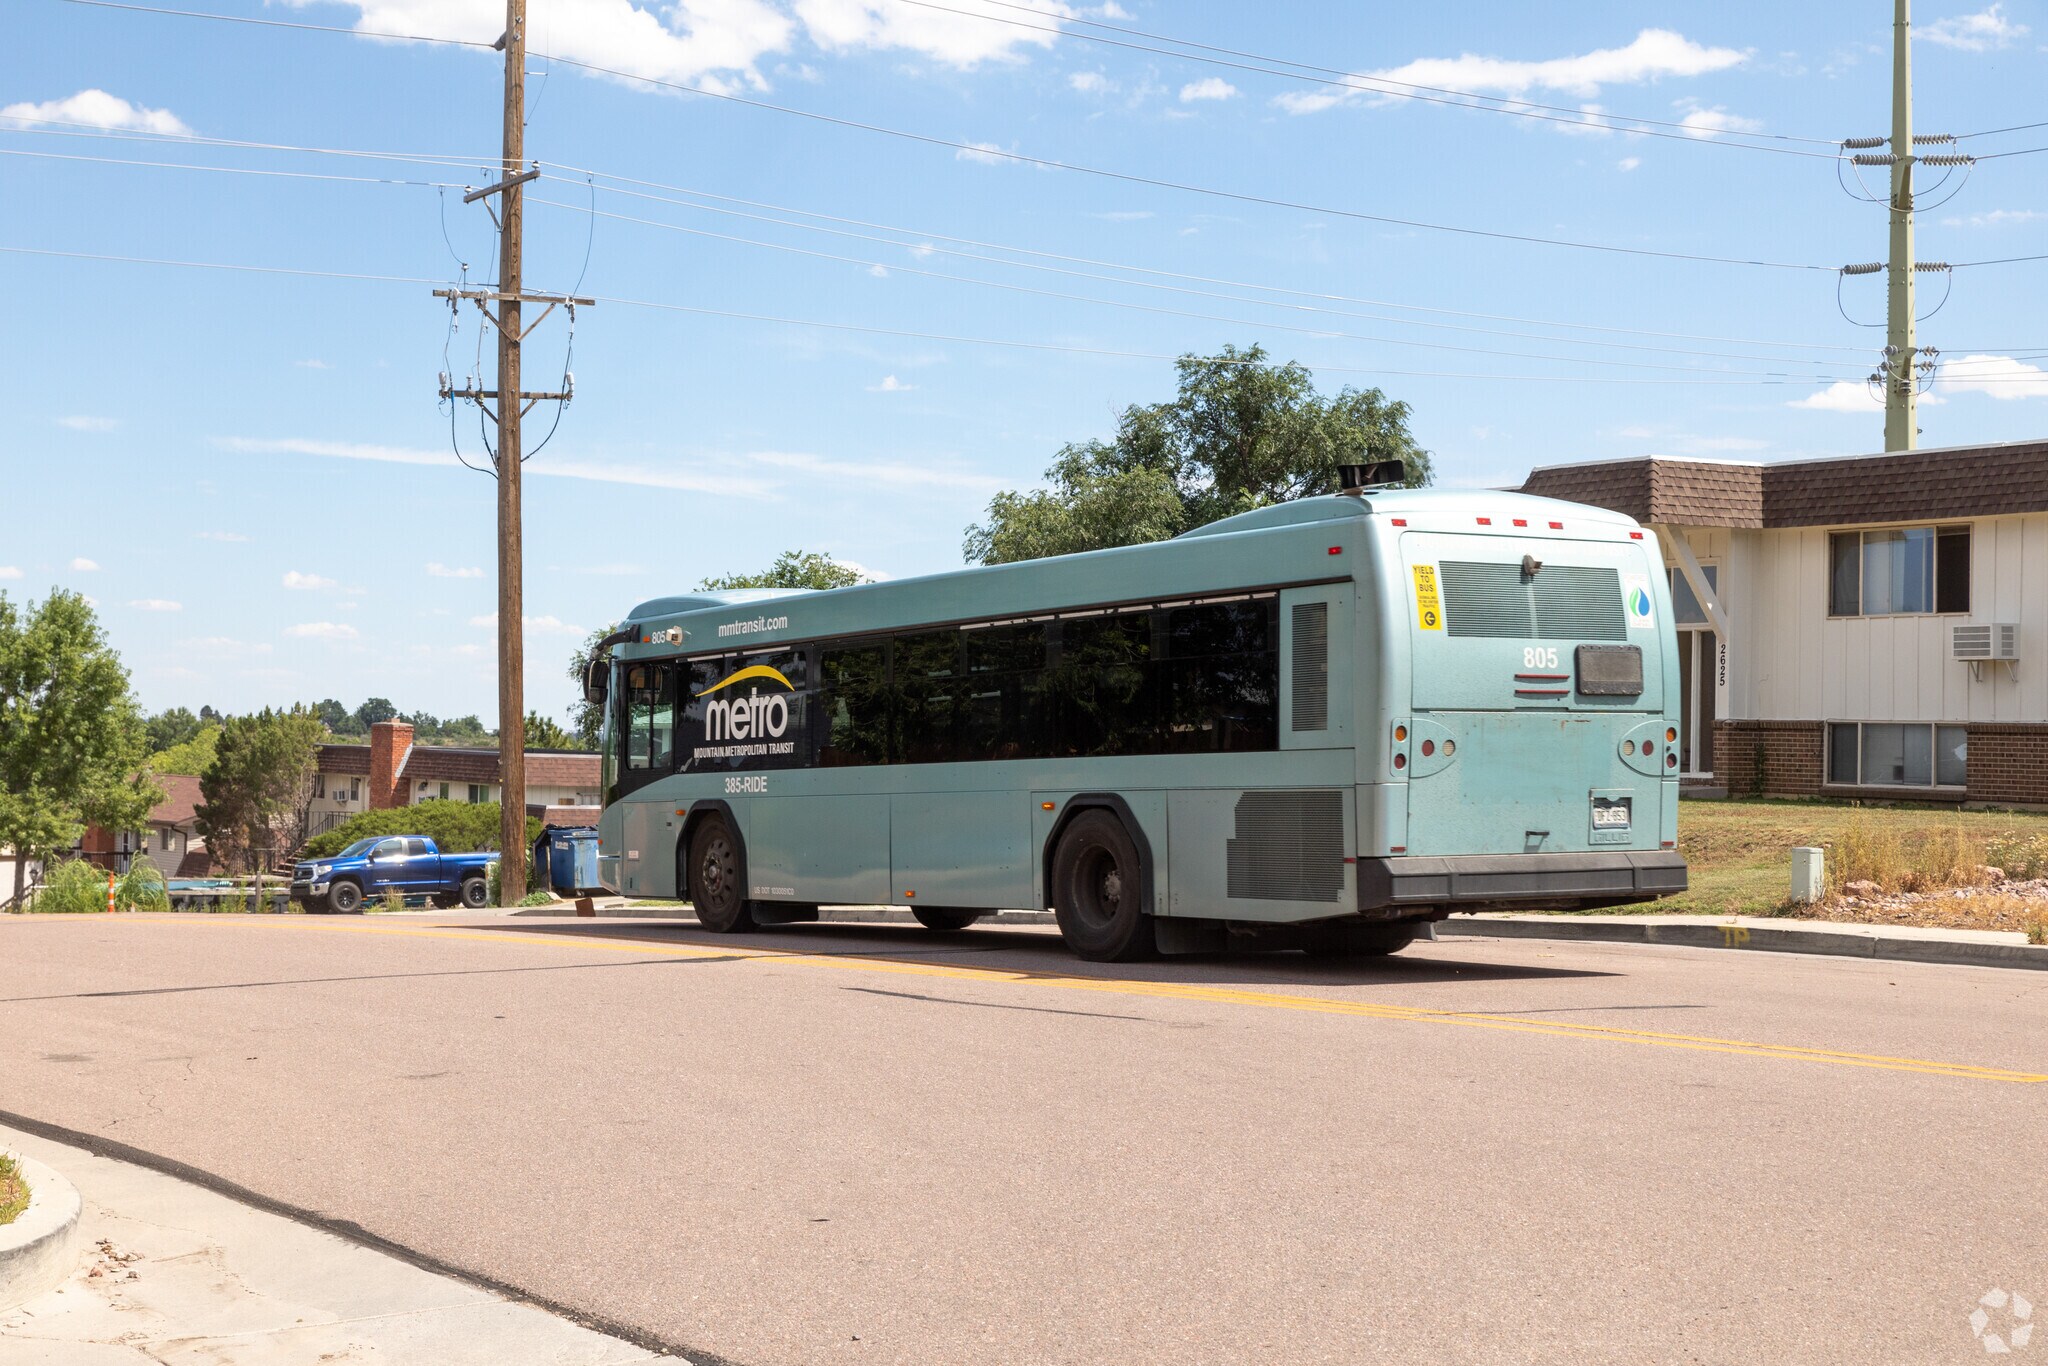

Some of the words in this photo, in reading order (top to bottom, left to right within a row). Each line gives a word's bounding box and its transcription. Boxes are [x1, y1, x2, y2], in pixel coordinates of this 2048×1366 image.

[1413, 566, 1434, 574] YIELD
[1420, 575, 1430, 583] TO
[1419, 584, 1433, 592] BUS
[718, 616, 788, 637] mmtransit.com
[652, 631, 666, 644] 805
[1523, 647, 1558, 668] 805
[705, 687, 788, 741] metro
[694, 746, 725, 758] MOUNTAIN
[725, 744, 767, 757] METROPOLITAN
[769, 742, 794, 754] TRANSIT
[725, 776, 767, 793] 385-RIDE
[754, 886, 760, 894] US
[761, 886, 770, 894] DOT
